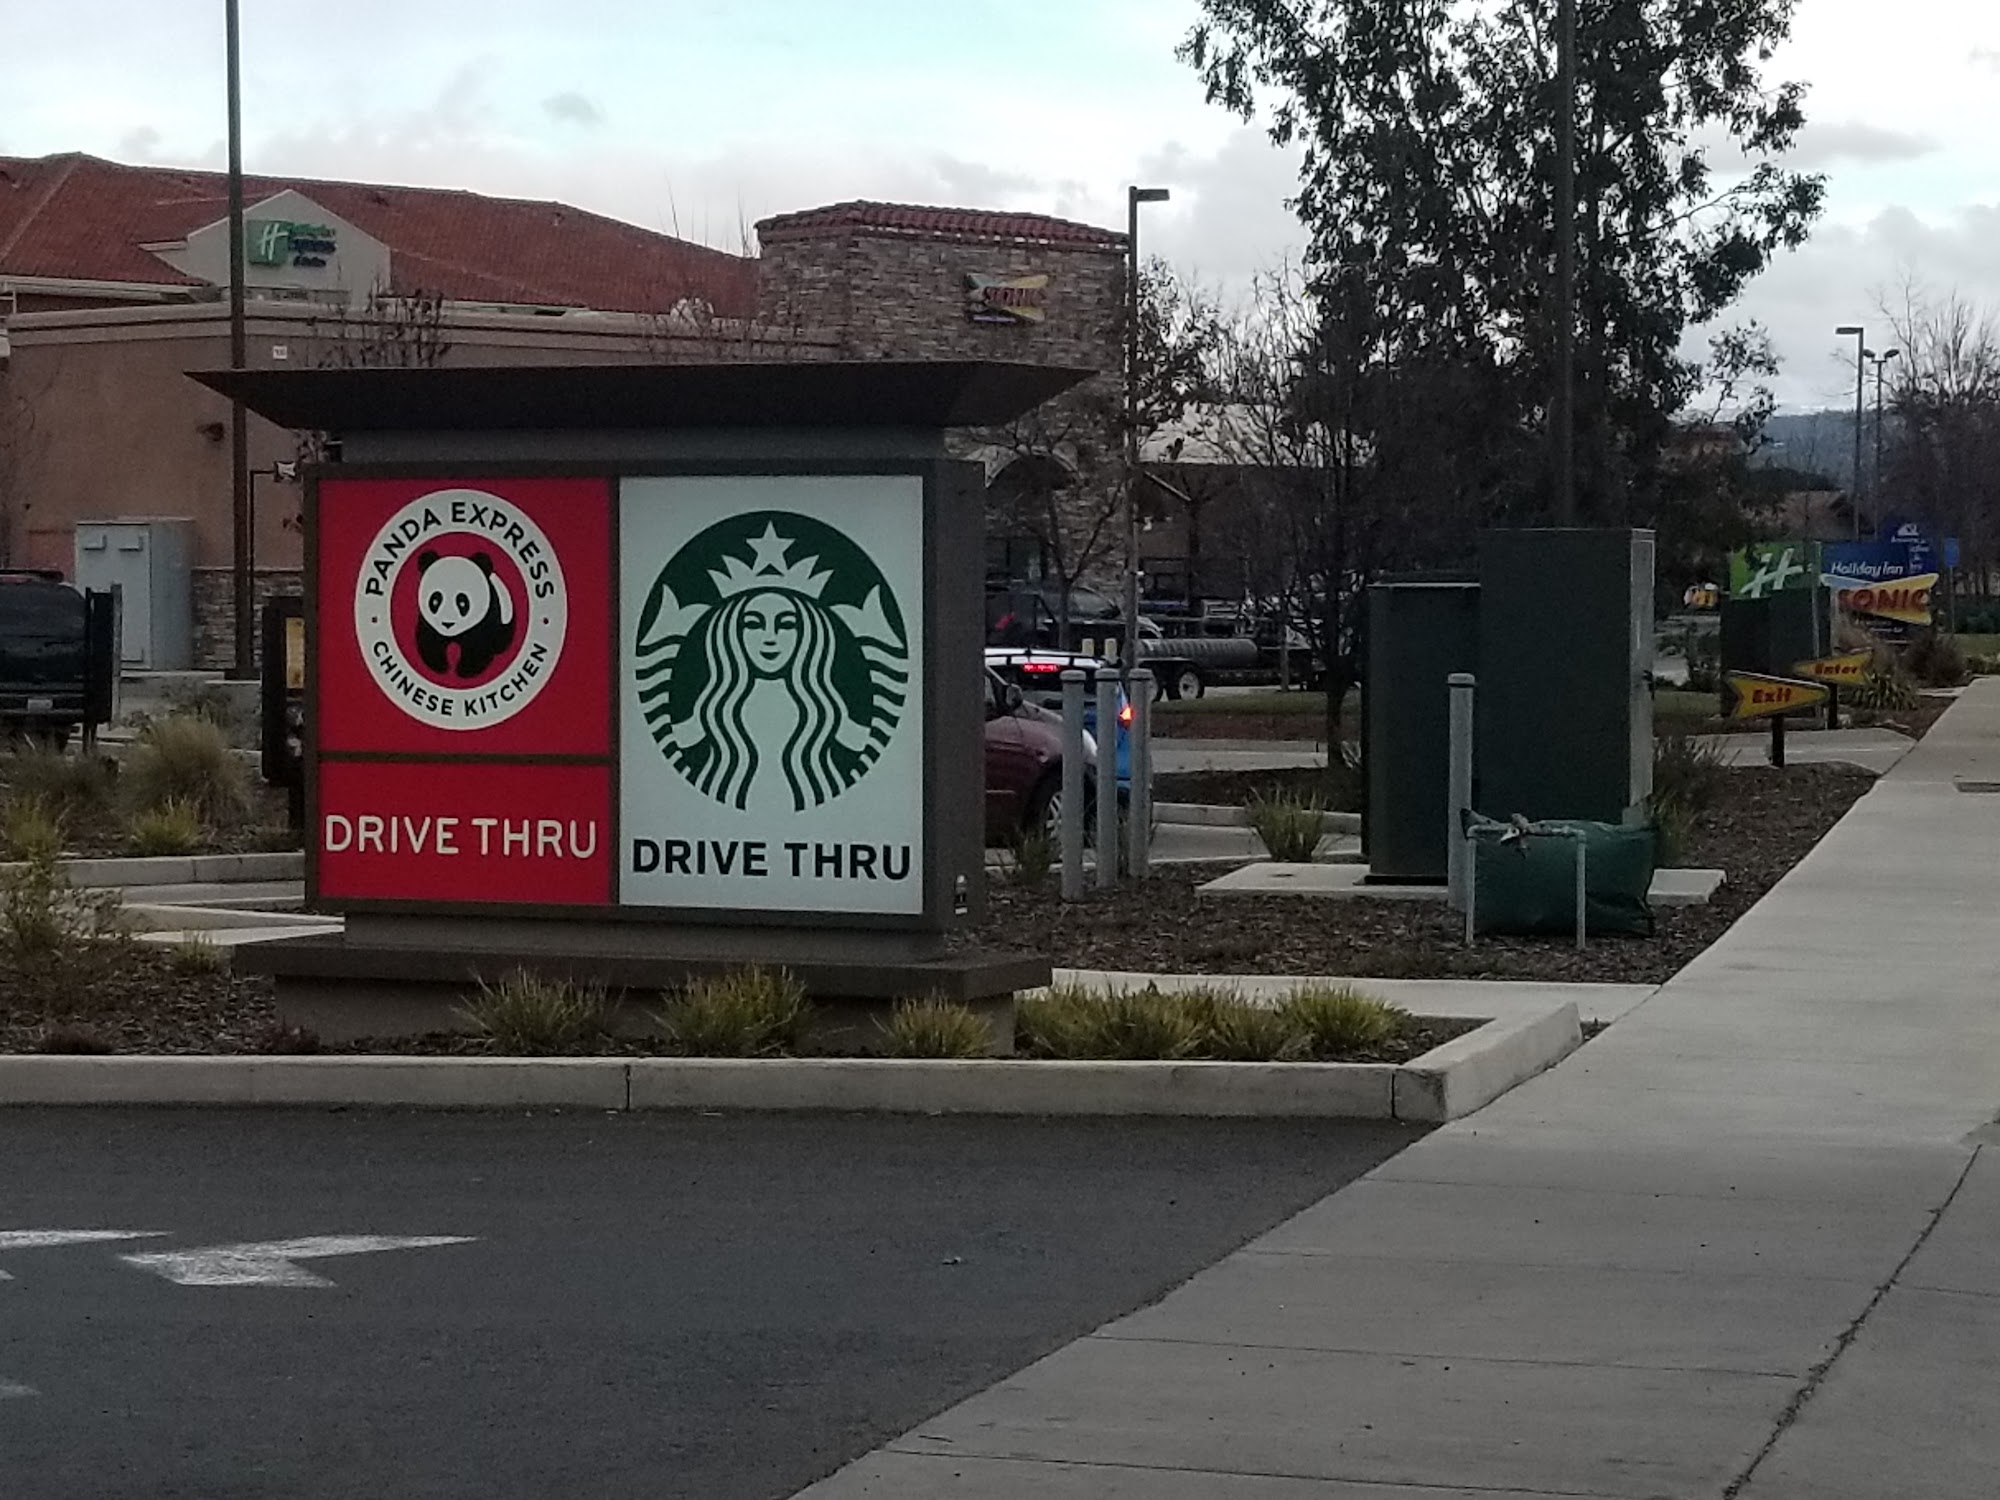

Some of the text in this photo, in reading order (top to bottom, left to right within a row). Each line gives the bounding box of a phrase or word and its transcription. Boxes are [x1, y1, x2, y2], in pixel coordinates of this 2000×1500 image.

[365, 502, 554, 599] PANDA EXPRESS
[1831, 561, 1881, 577] Holiday
[1883, 561, 1904, 575] Inn
[1838, 588, 1929, 613] SONIC
[373, 640, 547, 717] CHINESE KITCHEN
[1814, 662, 1858, 675] Enter
[1752, 687, 1792, 704] Exit
[324, 814, 596, 859] DRIVE THRU
[632, 838, 911, 881] DRIVE THRU
